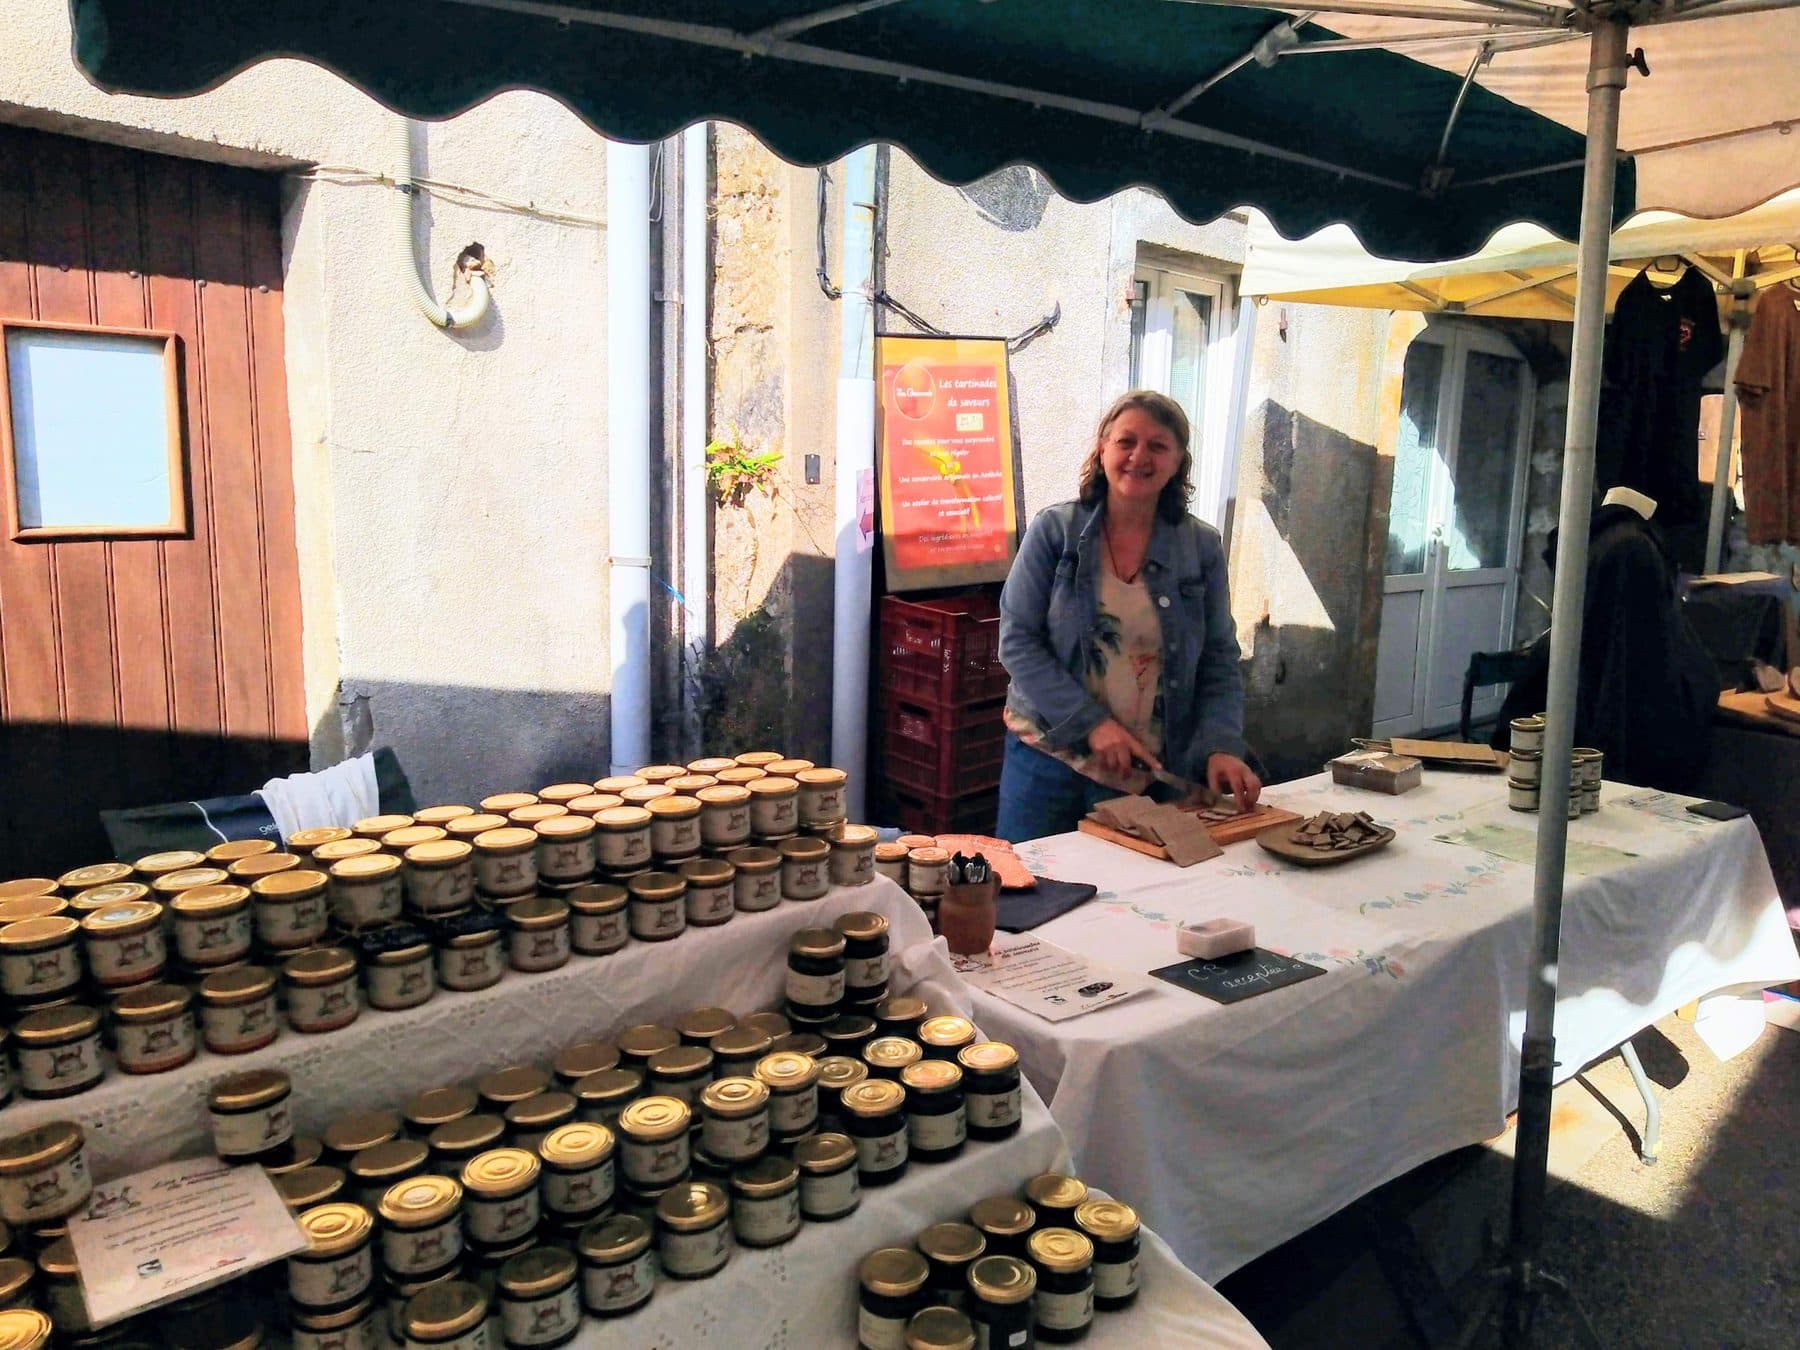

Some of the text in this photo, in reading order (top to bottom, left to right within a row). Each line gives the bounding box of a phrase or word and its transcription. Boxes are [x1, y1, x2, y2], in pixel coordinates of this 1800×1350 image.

[939, 377, 998, 389] Les tartinades
[947, 396, 990, 408] de saveurs
